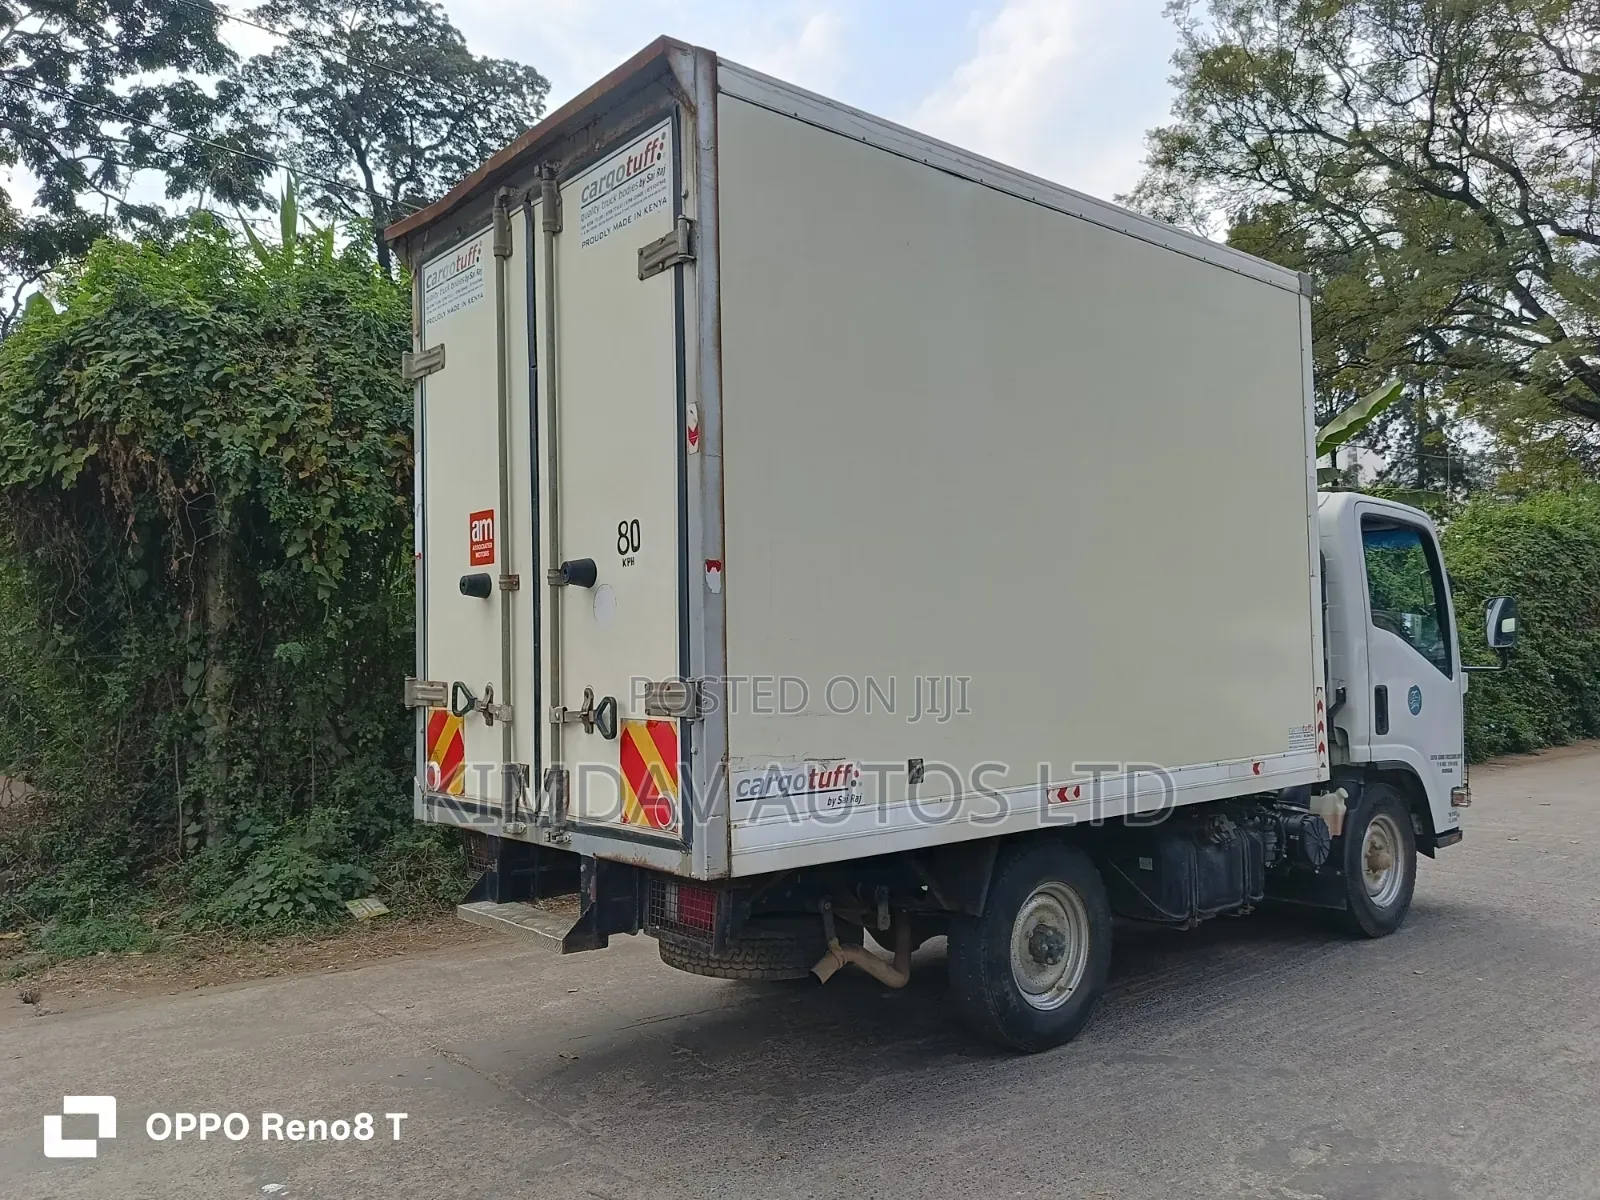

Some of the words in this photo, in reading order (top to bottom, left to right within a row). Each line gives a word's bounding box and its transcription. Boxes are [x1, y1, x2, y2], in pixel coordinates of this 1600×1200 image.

[581, 137, 660, 203] cargotuff
[601, 196, 617, 210] truck
[618, 182, 639, 200] bodies
[639, 177, 646, 188] by
[646, 169, 656, 183] Sai
[656, 164, 666, 179] Raj
[581, 227, 611, 249] PROUDLY
[612, 215, 632, 231] MADE
[634, 209, 641, 220] IN
[644, 196, 667, 214] KENYA
[471, 518, 493, 542] am
[617, 518, 640, 556] 80
[622, 556, 635, 568] KPH
[736, 763, 854, 798] cargotuff
[827, 796, 836, 806] by
[837, 794, 849, 805] Sai
[851, 793, 863, 804] Raj
